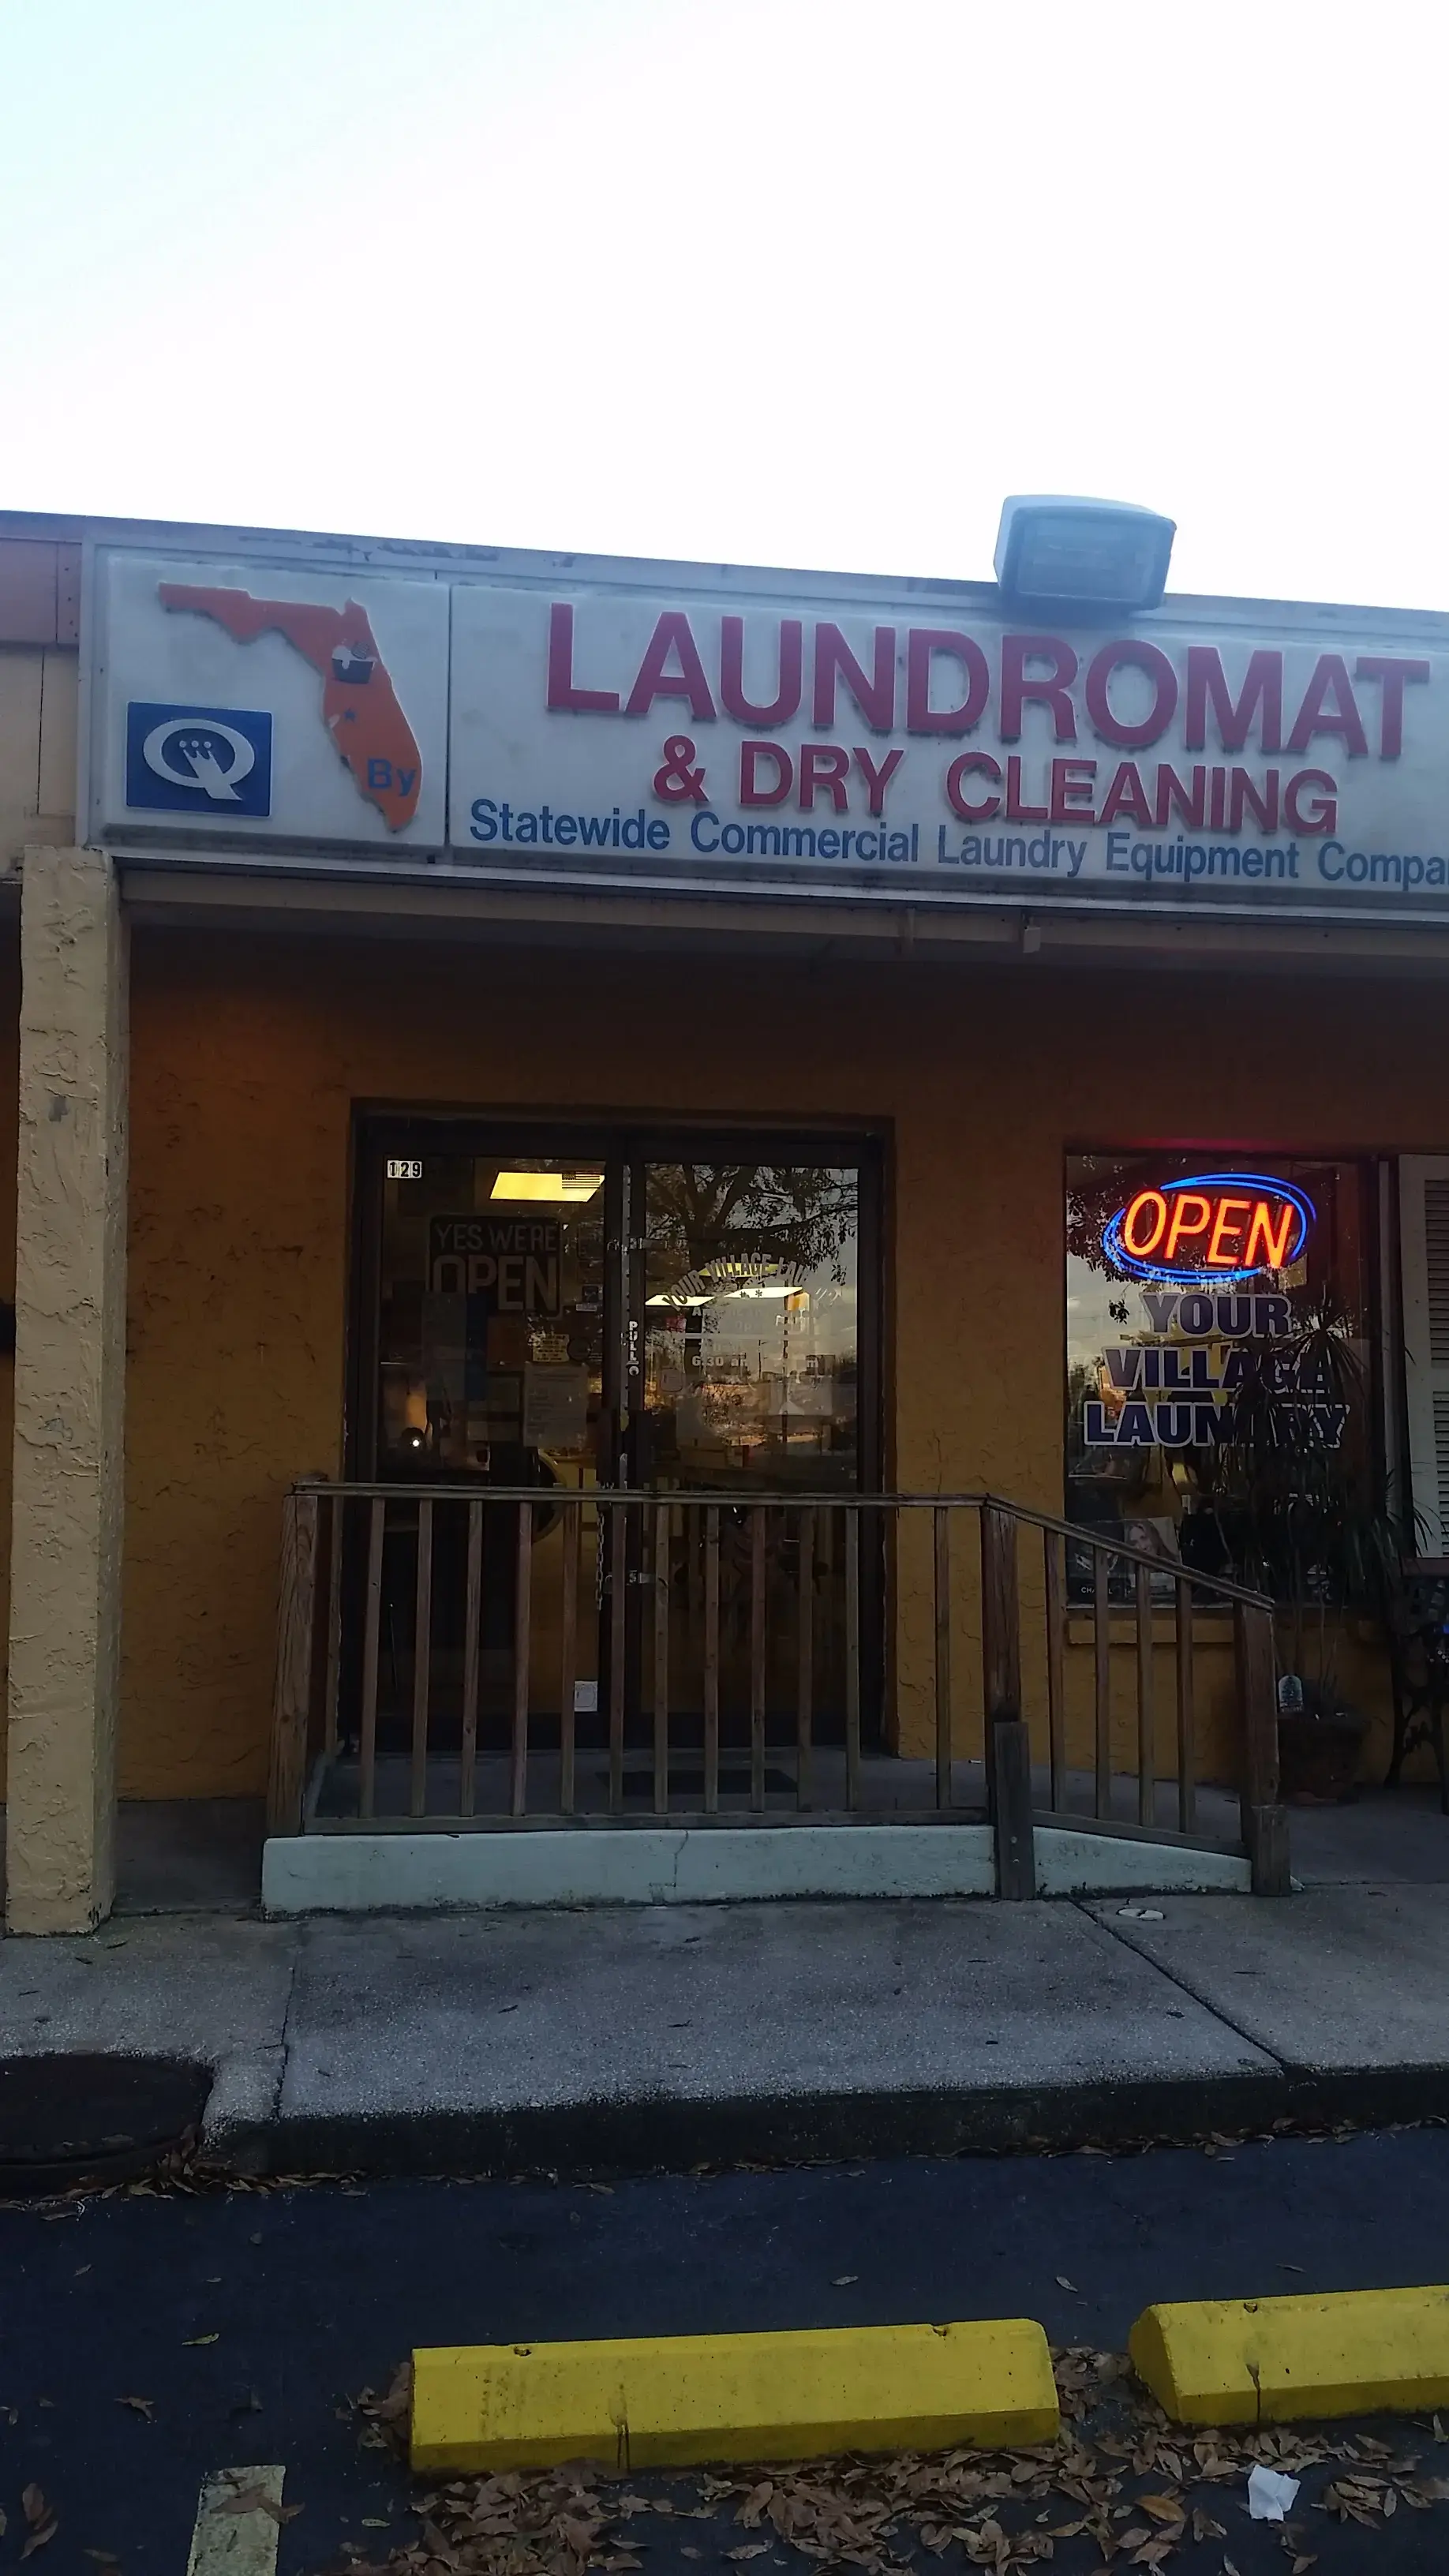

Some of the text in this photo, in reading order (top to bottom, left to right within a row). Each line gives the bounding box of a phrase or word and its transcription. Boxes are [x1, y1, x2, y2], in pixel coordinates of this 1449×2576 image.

[546, 602, 1431, 758] LAUNDROMAT
[367, 758, 417, 797] By
[653, 734, 1339, 834] & DRY CLEANING
[470, 798, 1449, 892] Statewide Commercial Laundry Equipment Compa
[388, 1161, 421, 1178] 129
[435, 1222, 483, 1251] YES
[1123, 1190, 1294, 1269] OPEN
[433, 1253, 556, 1310] OPEN
[661, 1269, 706, 1312] YOUR
[704, 1252, 773, 1283] VILLAGE
[628, 1320, 638, 1361] PULL
[1140, 1292, 1293, 1339] YOUR
